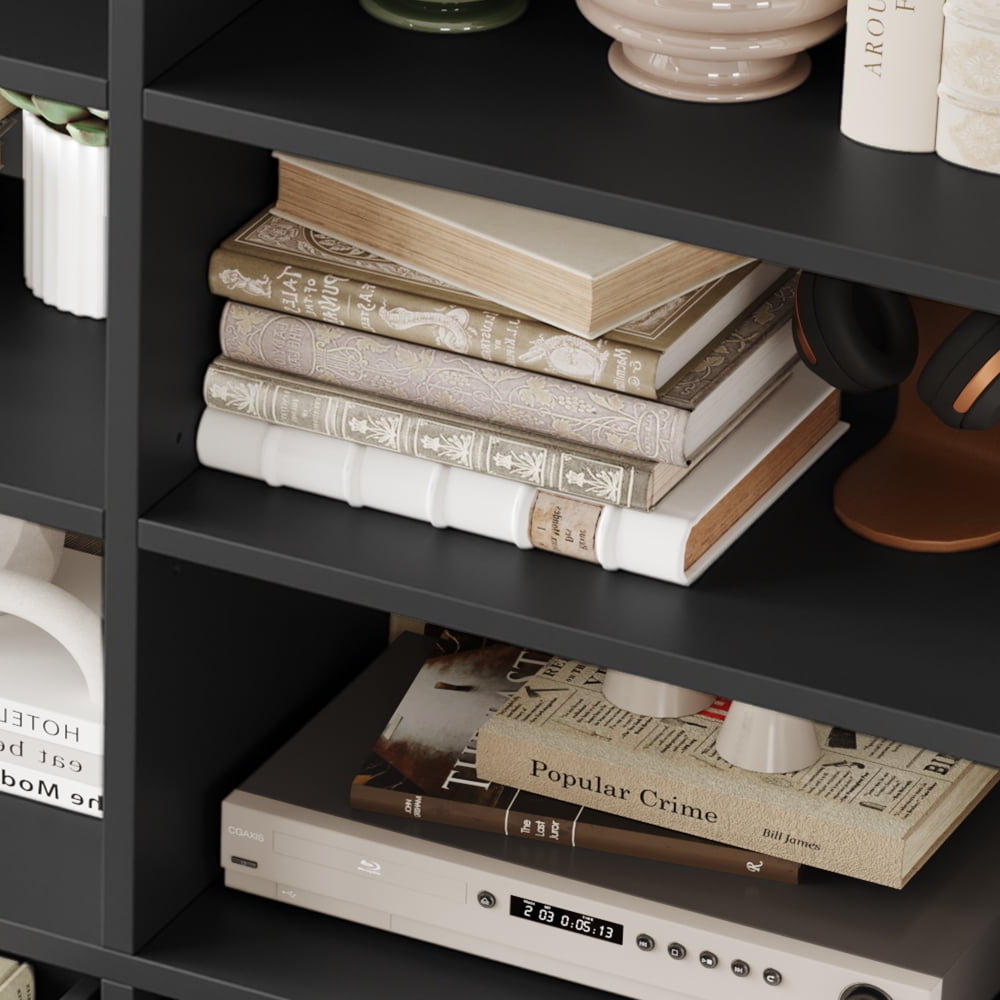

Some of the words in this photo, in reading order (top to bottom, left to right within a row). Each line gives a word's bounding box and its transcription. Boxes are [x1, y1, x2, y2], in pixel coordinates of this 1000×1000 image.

[529, 758, 631, 800] Popular
[639, 788, 719, 824] Crime
[520, 818, 532, 834] The
[535, 820, 546, 837] Last
[549, 820, 561, 840] Juror
[762, 827, 783, 842] Bill
[784, 833, 821, 851] James
[523, 905, 534, 918] 2
[538, 909, 555, 923] 03
[560, 915, 614, 939] 0:05:13
